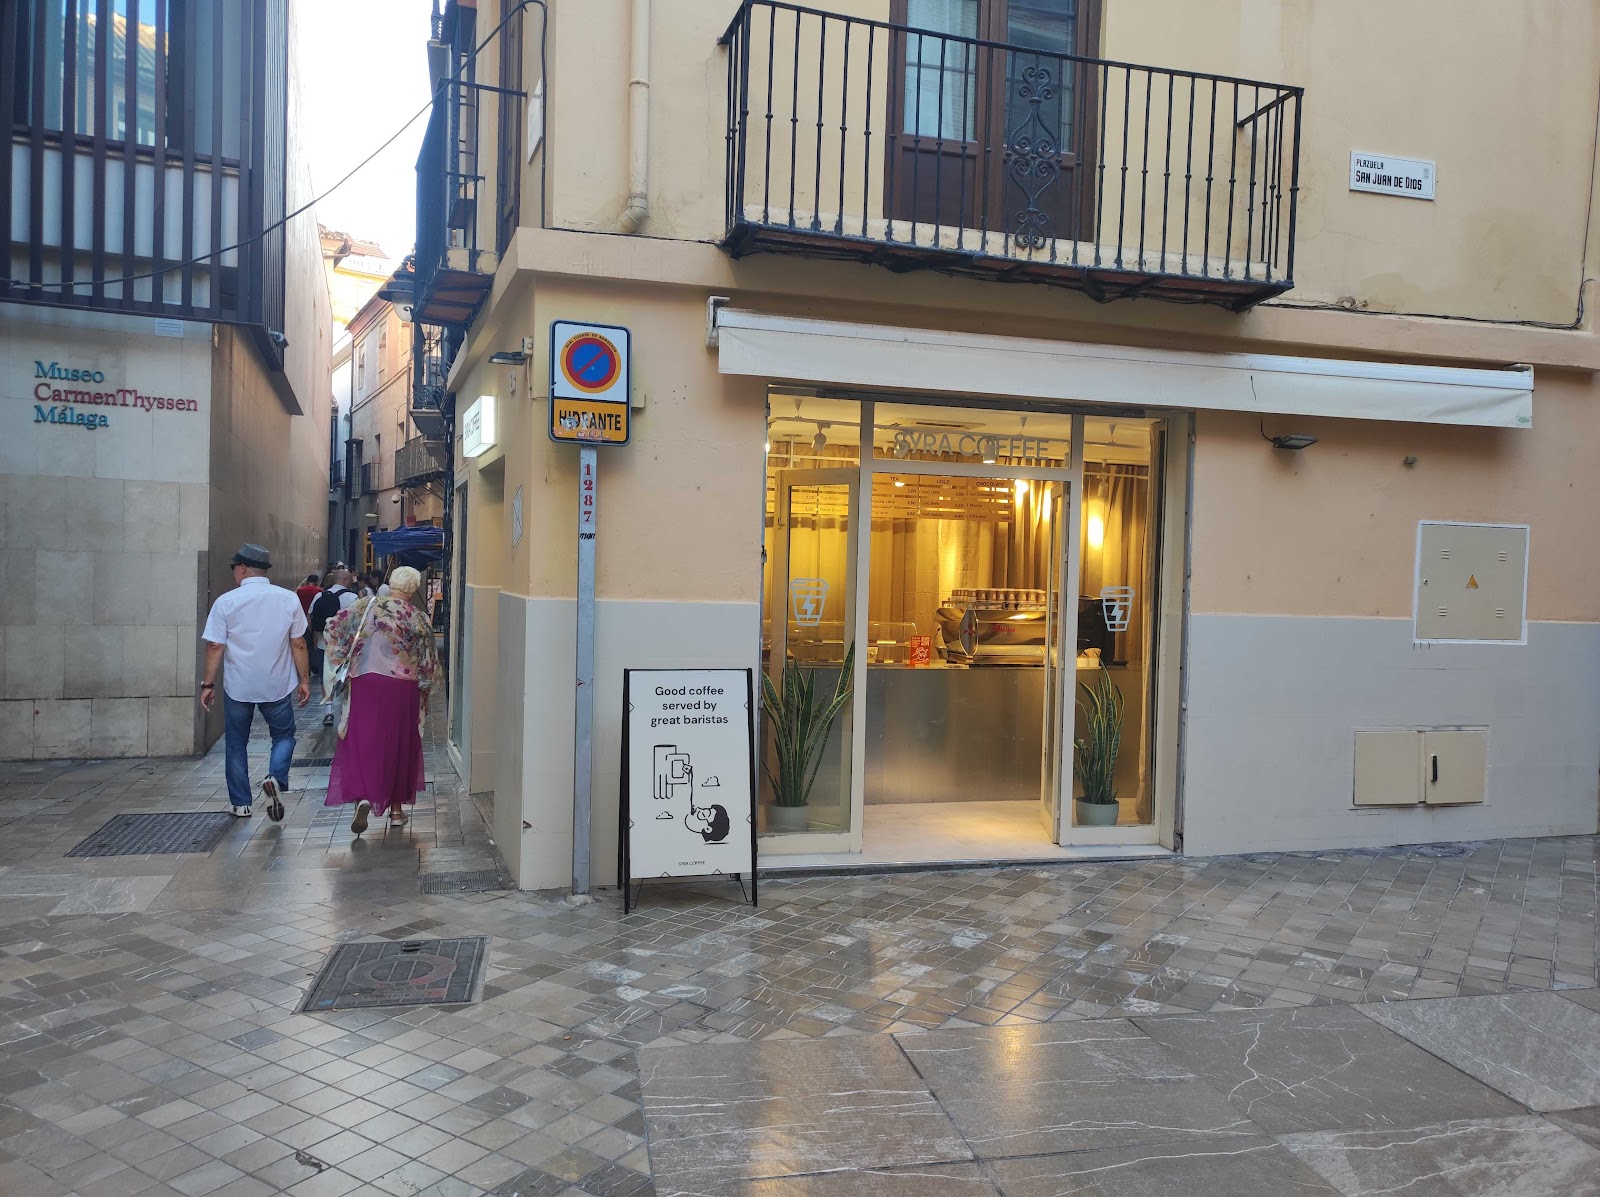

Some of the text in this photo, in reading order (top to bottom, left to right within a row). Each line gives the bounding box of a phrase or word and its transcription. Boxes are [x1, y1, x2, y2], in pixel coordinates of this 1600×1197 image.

[1356, 159, 1384, 170] PLAZUELA
[1356, 170, 1422, 191] SAN JUAN DE DIOS
[34, 360, 105, 383] Museo
[34, 382, 198, 412] CarmenThyssen
[34, 404, 109, 430] Málaga
[894, 431, 1050, 460] SYRA COFFEE
[583, 463, 593, 522] 1287
[655, 686, 724, 696] Good coffee
[662, 700, 717, 712] served by
[650, 715, 729, 728] great baristas
